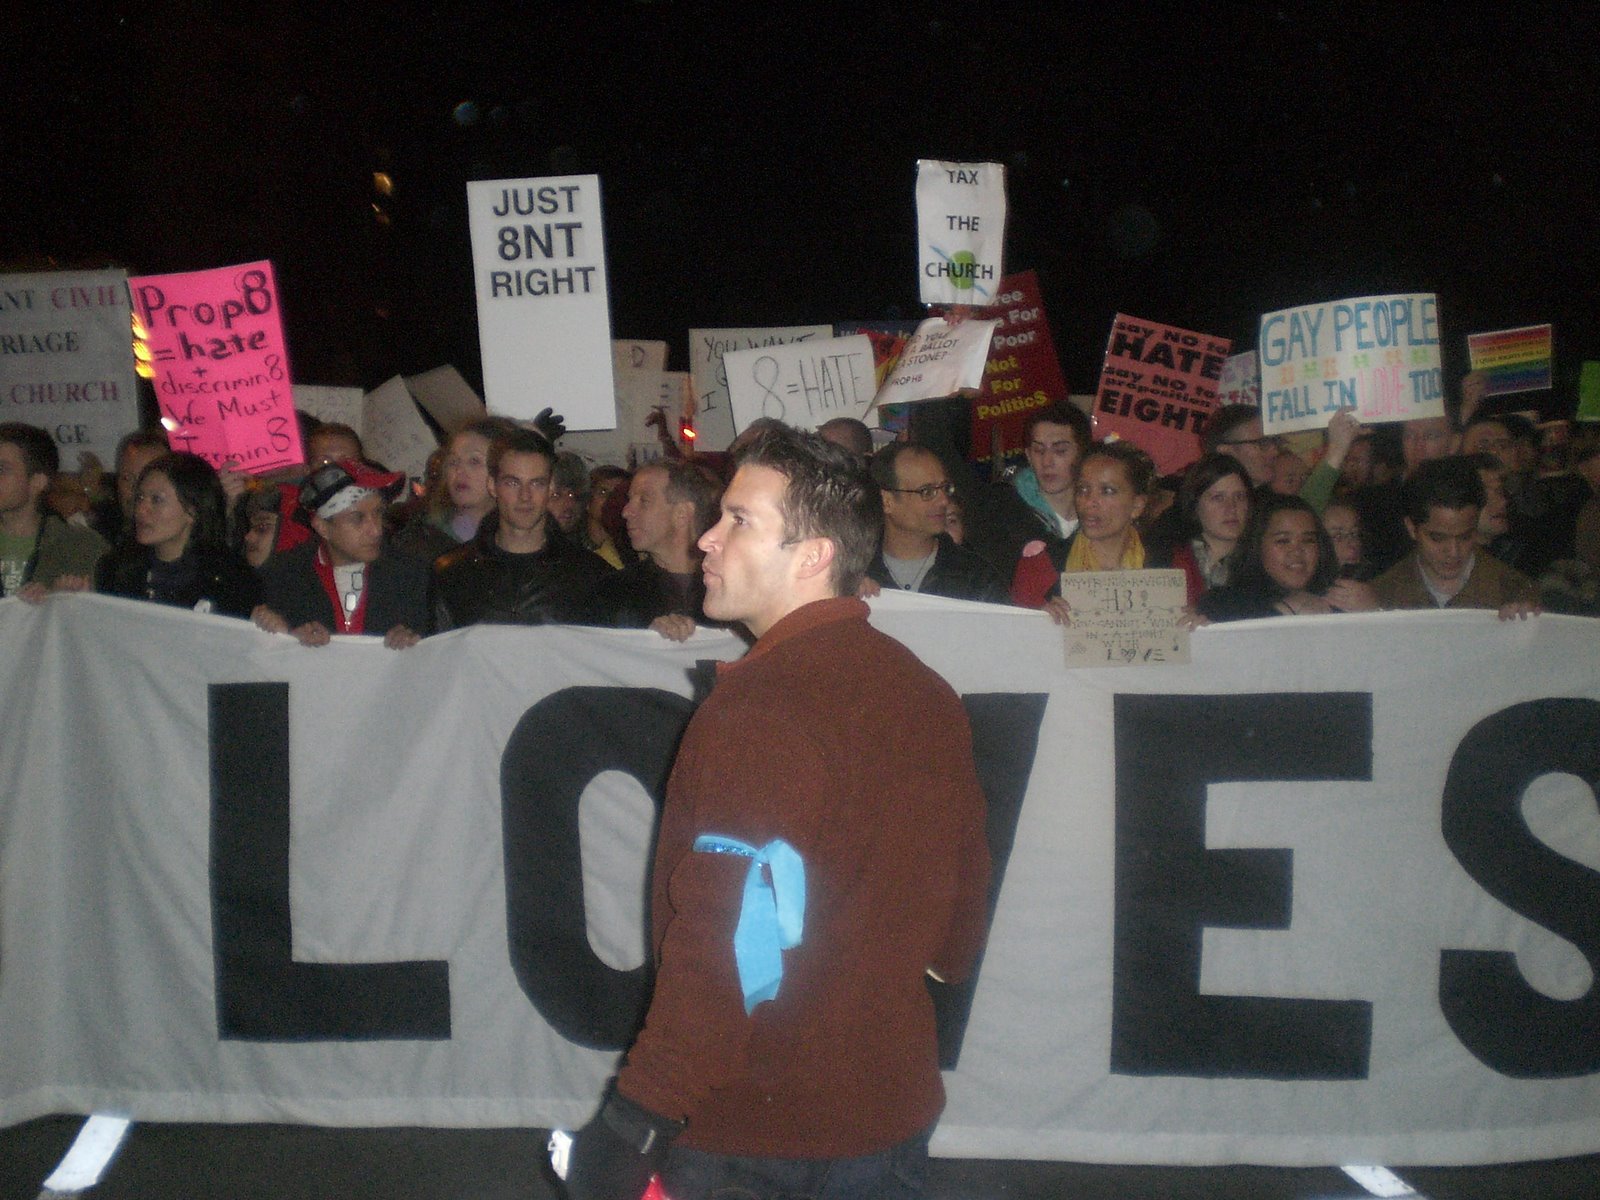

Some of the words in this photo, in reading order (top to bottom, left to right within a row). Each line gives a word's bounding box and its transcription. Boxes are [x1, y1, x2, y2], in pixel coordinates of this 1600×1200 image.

[946, 170, 978, 185] TAX
[493, 186, 580, 216] JUST
[946, 215, 980, 231] THE
[498, 222, 582, 261] 8NT
[925, 262, 993, 279] CHURCH
[490, 267, 595, 297] RIGHT
[1009, 307, 1039, 324] For
[993, 330, 1036, 350] Poor
[1164, 329, 1199, 346] NO
[1262, 308, 1324, 366] GAY
[1333, 298, 1439, 352] PEOPLE
[920, 339, 960, 352] BALLOT
[907, 351, 948, 366] STONE?
[1112, 332, 1226, 381] HATE
[10, 381, 119, 403] CHURCH
[991, 378, 1021, 394] For
[1152, 374, 1187, 391] NO
[1268, 386, 1317, 423] FALL
[1323, 378, 1358, 412] IN
[1359, 359, 1409, 417] LOVE
[1408, 367, 1442, 403] TOO
[165, 399, 207, 426] We
[217, 391, 282, 421] Must
[1100, 389, 1210, 434] EIGHT
